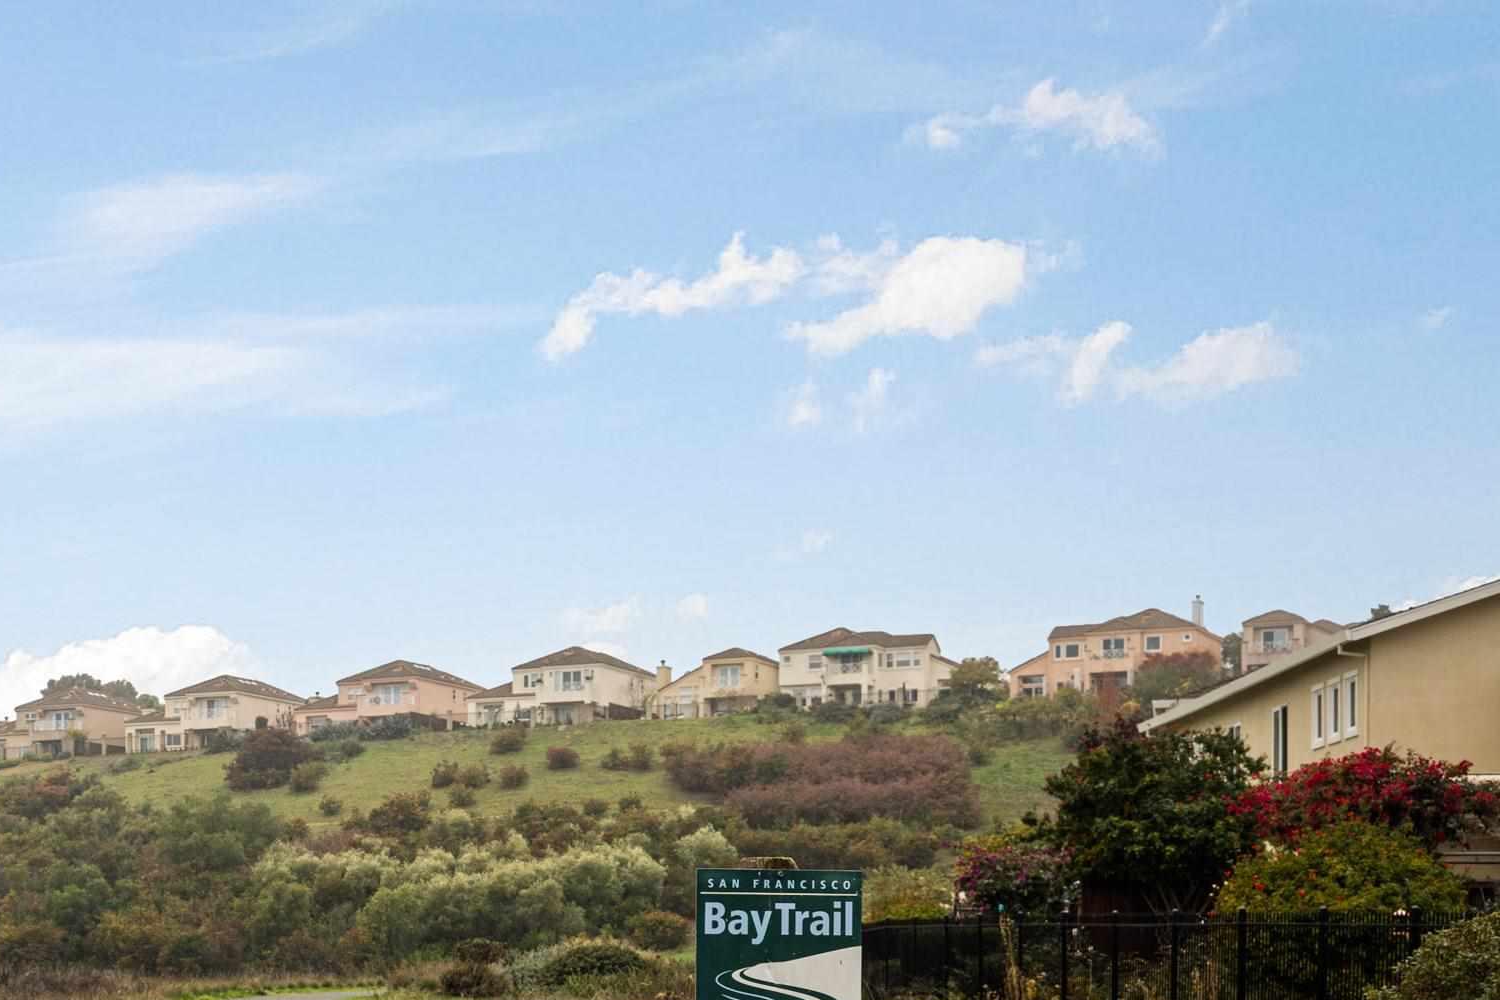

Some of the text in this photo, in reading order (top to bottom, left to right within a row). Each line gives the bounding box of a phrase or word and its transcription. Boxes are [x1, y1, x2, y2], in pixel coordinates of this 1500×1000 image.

[707, 878, 851, 890] SAN FRANCISCO
[703, 901, 853, 945] Bay Trail
